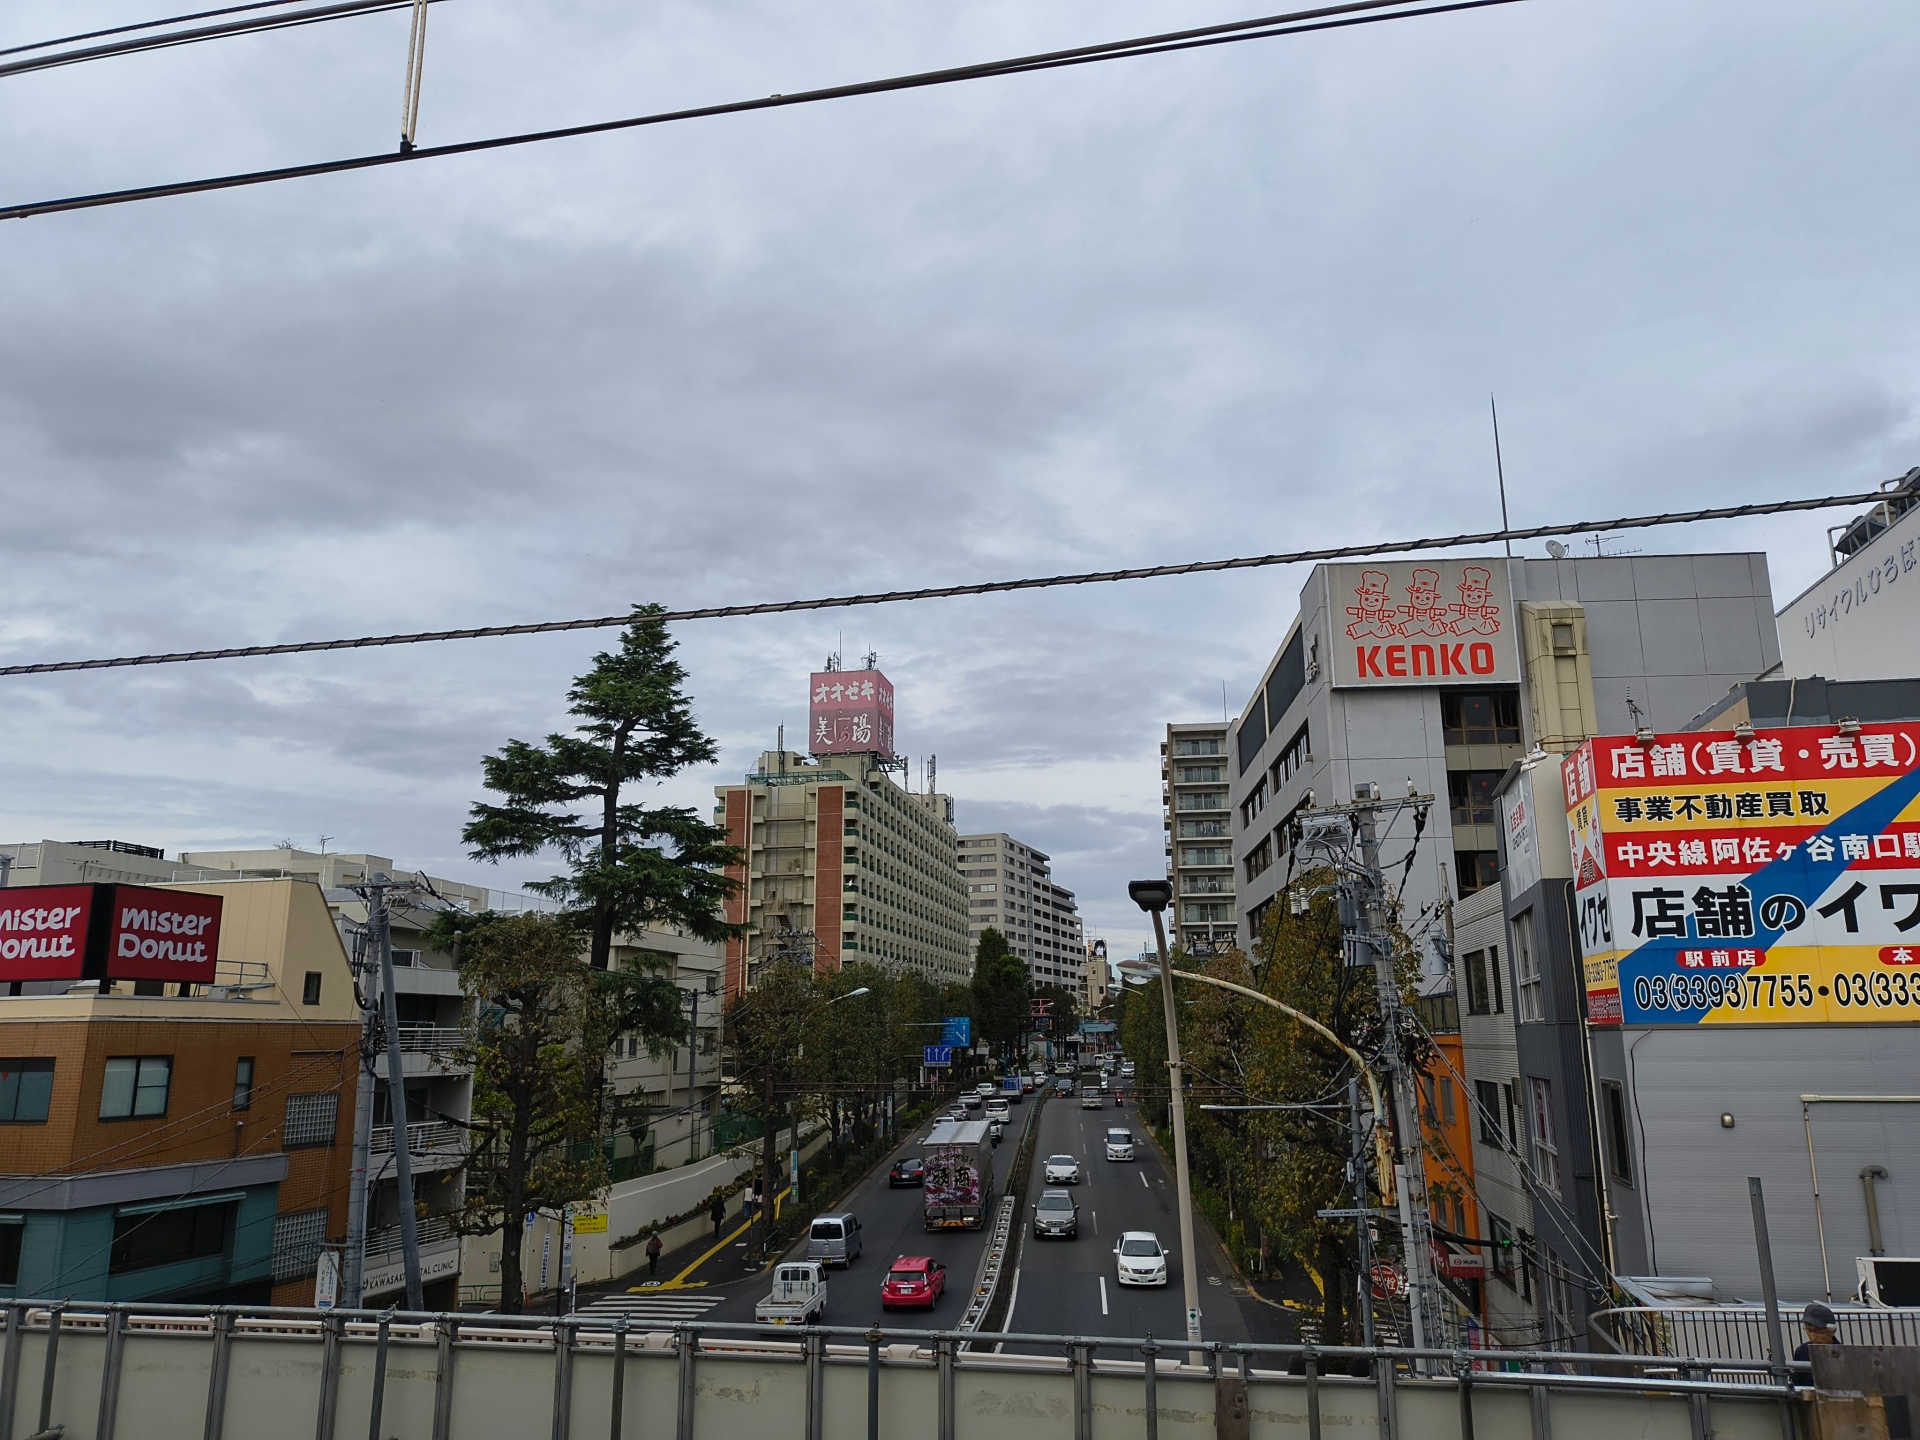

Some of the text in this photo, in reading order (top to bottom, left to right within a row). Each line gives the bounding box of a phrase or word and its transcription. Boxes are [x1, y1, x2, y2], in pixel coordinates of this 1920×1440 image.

[1805, 534, 1920, 638] リサイクルひろば
[1356, 642, 1495, 678] KENKO
[813, 679, 875, 704] オオゼキ
[1565, 748, 1591, 805] 店舗
[1614, 790, 1831, 823] 事業不動産買取
[1580, 892, 1611, 949] イワセ
[0, 935, 76, 959] onut
[117, 933, 208, 963] Donut
[1685, 949, 1756, 967] 駅前店
[433, 1260, 454, 1273] CLINIC
